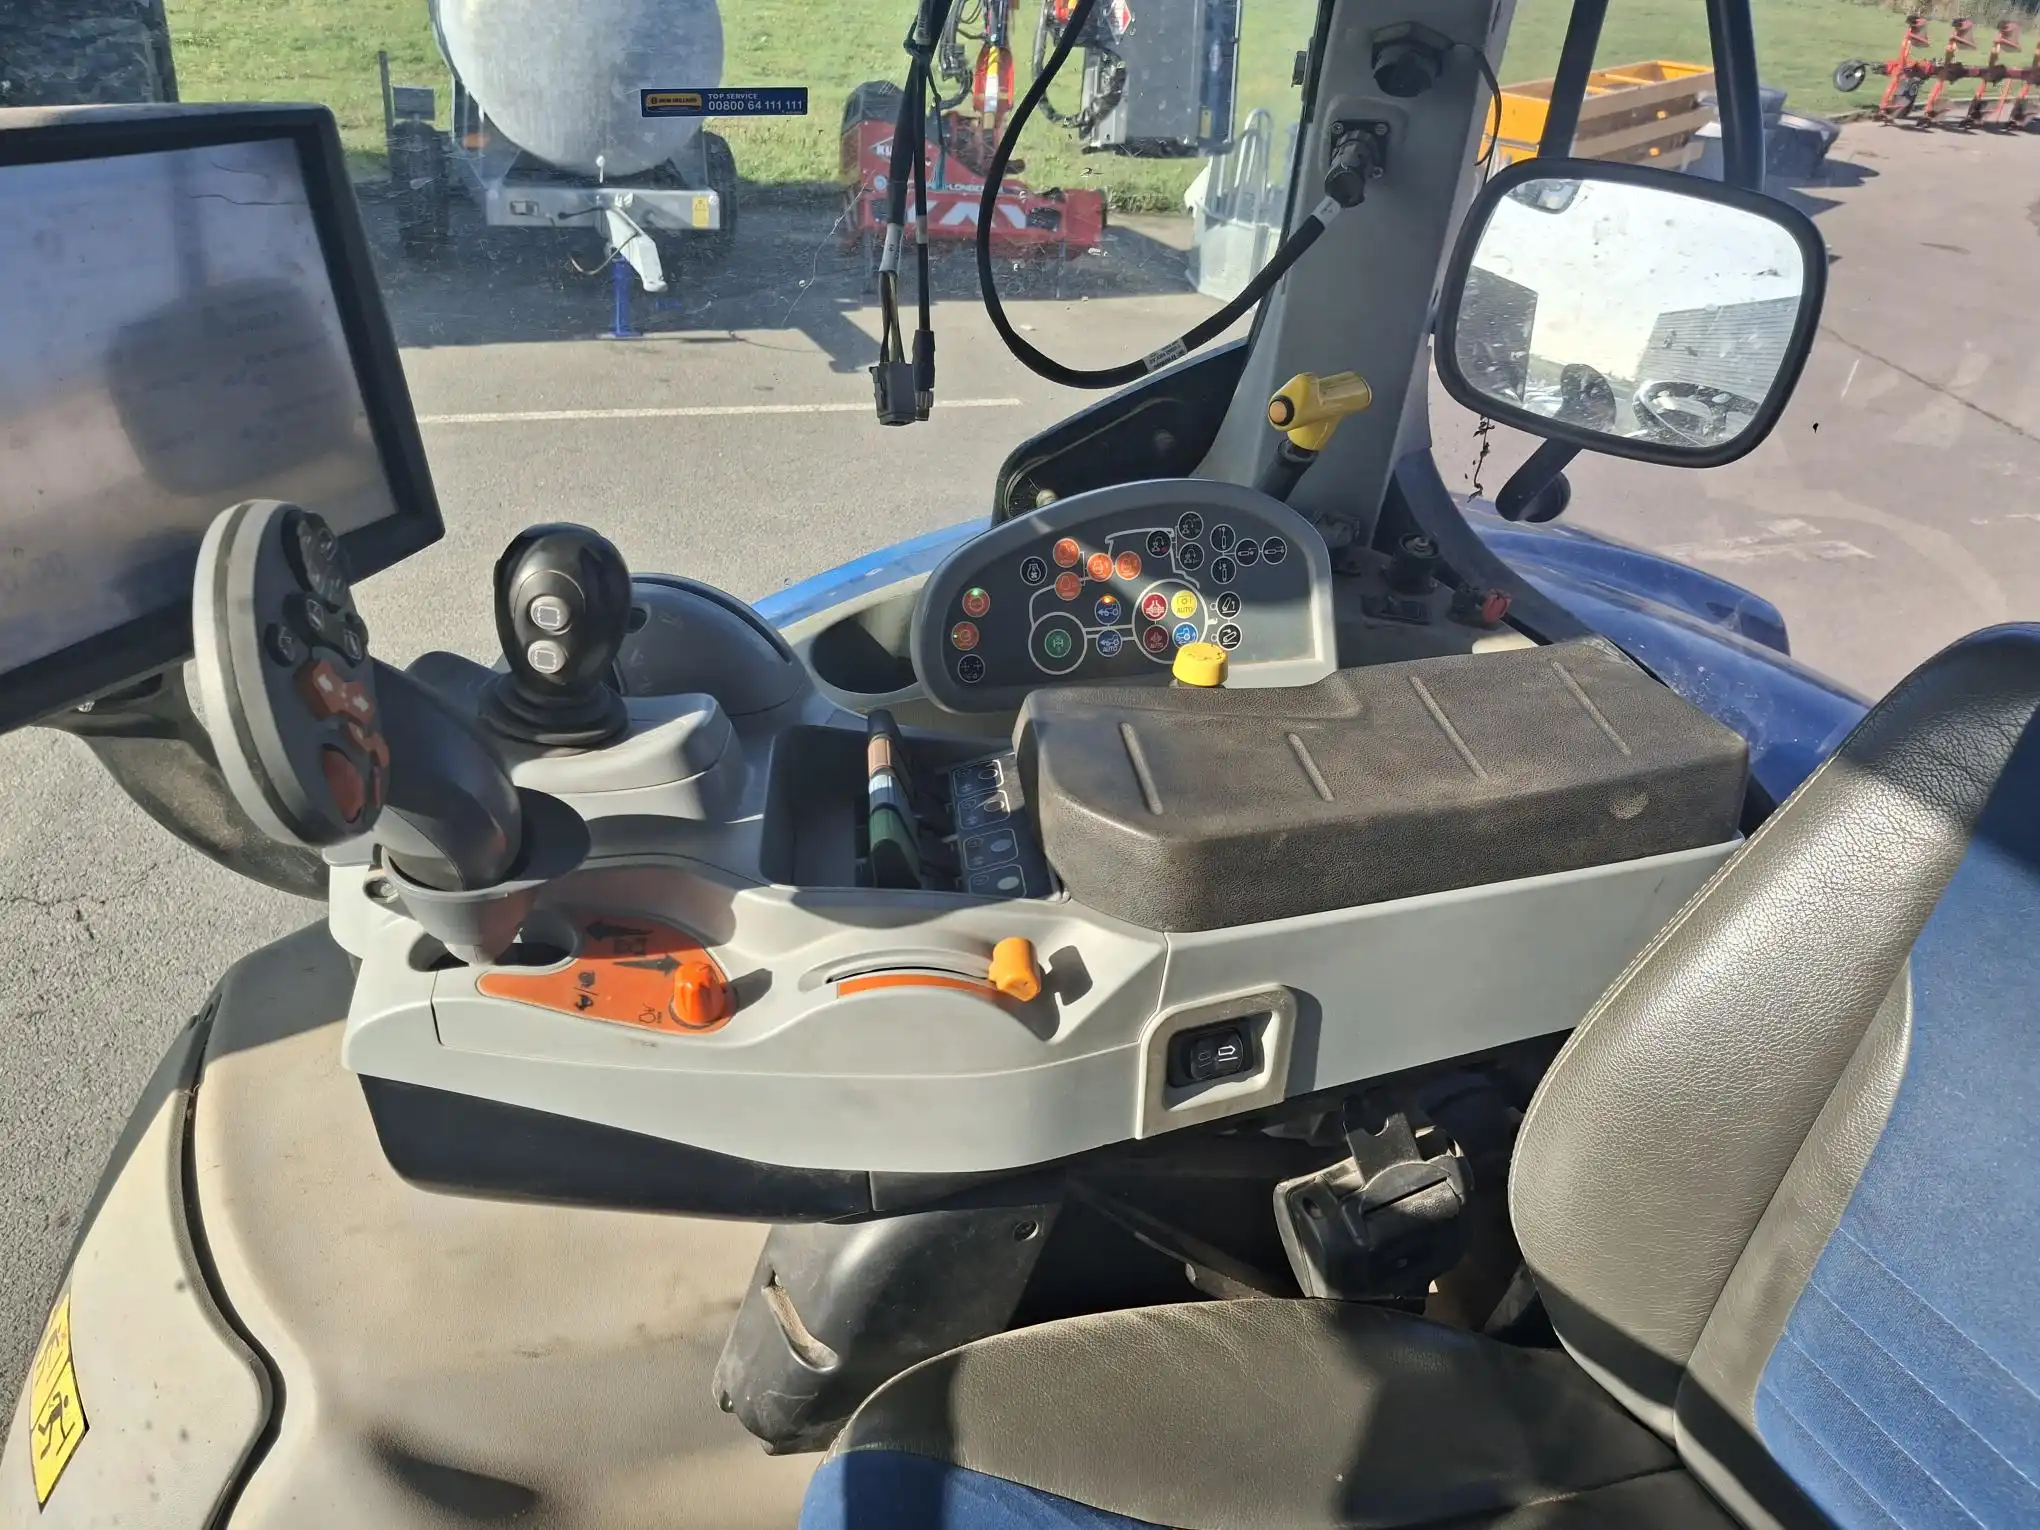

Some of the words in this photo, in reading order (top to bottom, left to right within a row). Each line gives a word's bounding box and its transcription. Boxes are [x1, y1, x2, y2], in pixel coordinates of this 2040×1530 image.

[708, 100, 745, 111] 00800
[747, 100, 762, 110] 64
[764, 99, 782, 110] 111
[785, 99, 803, 110] 111
